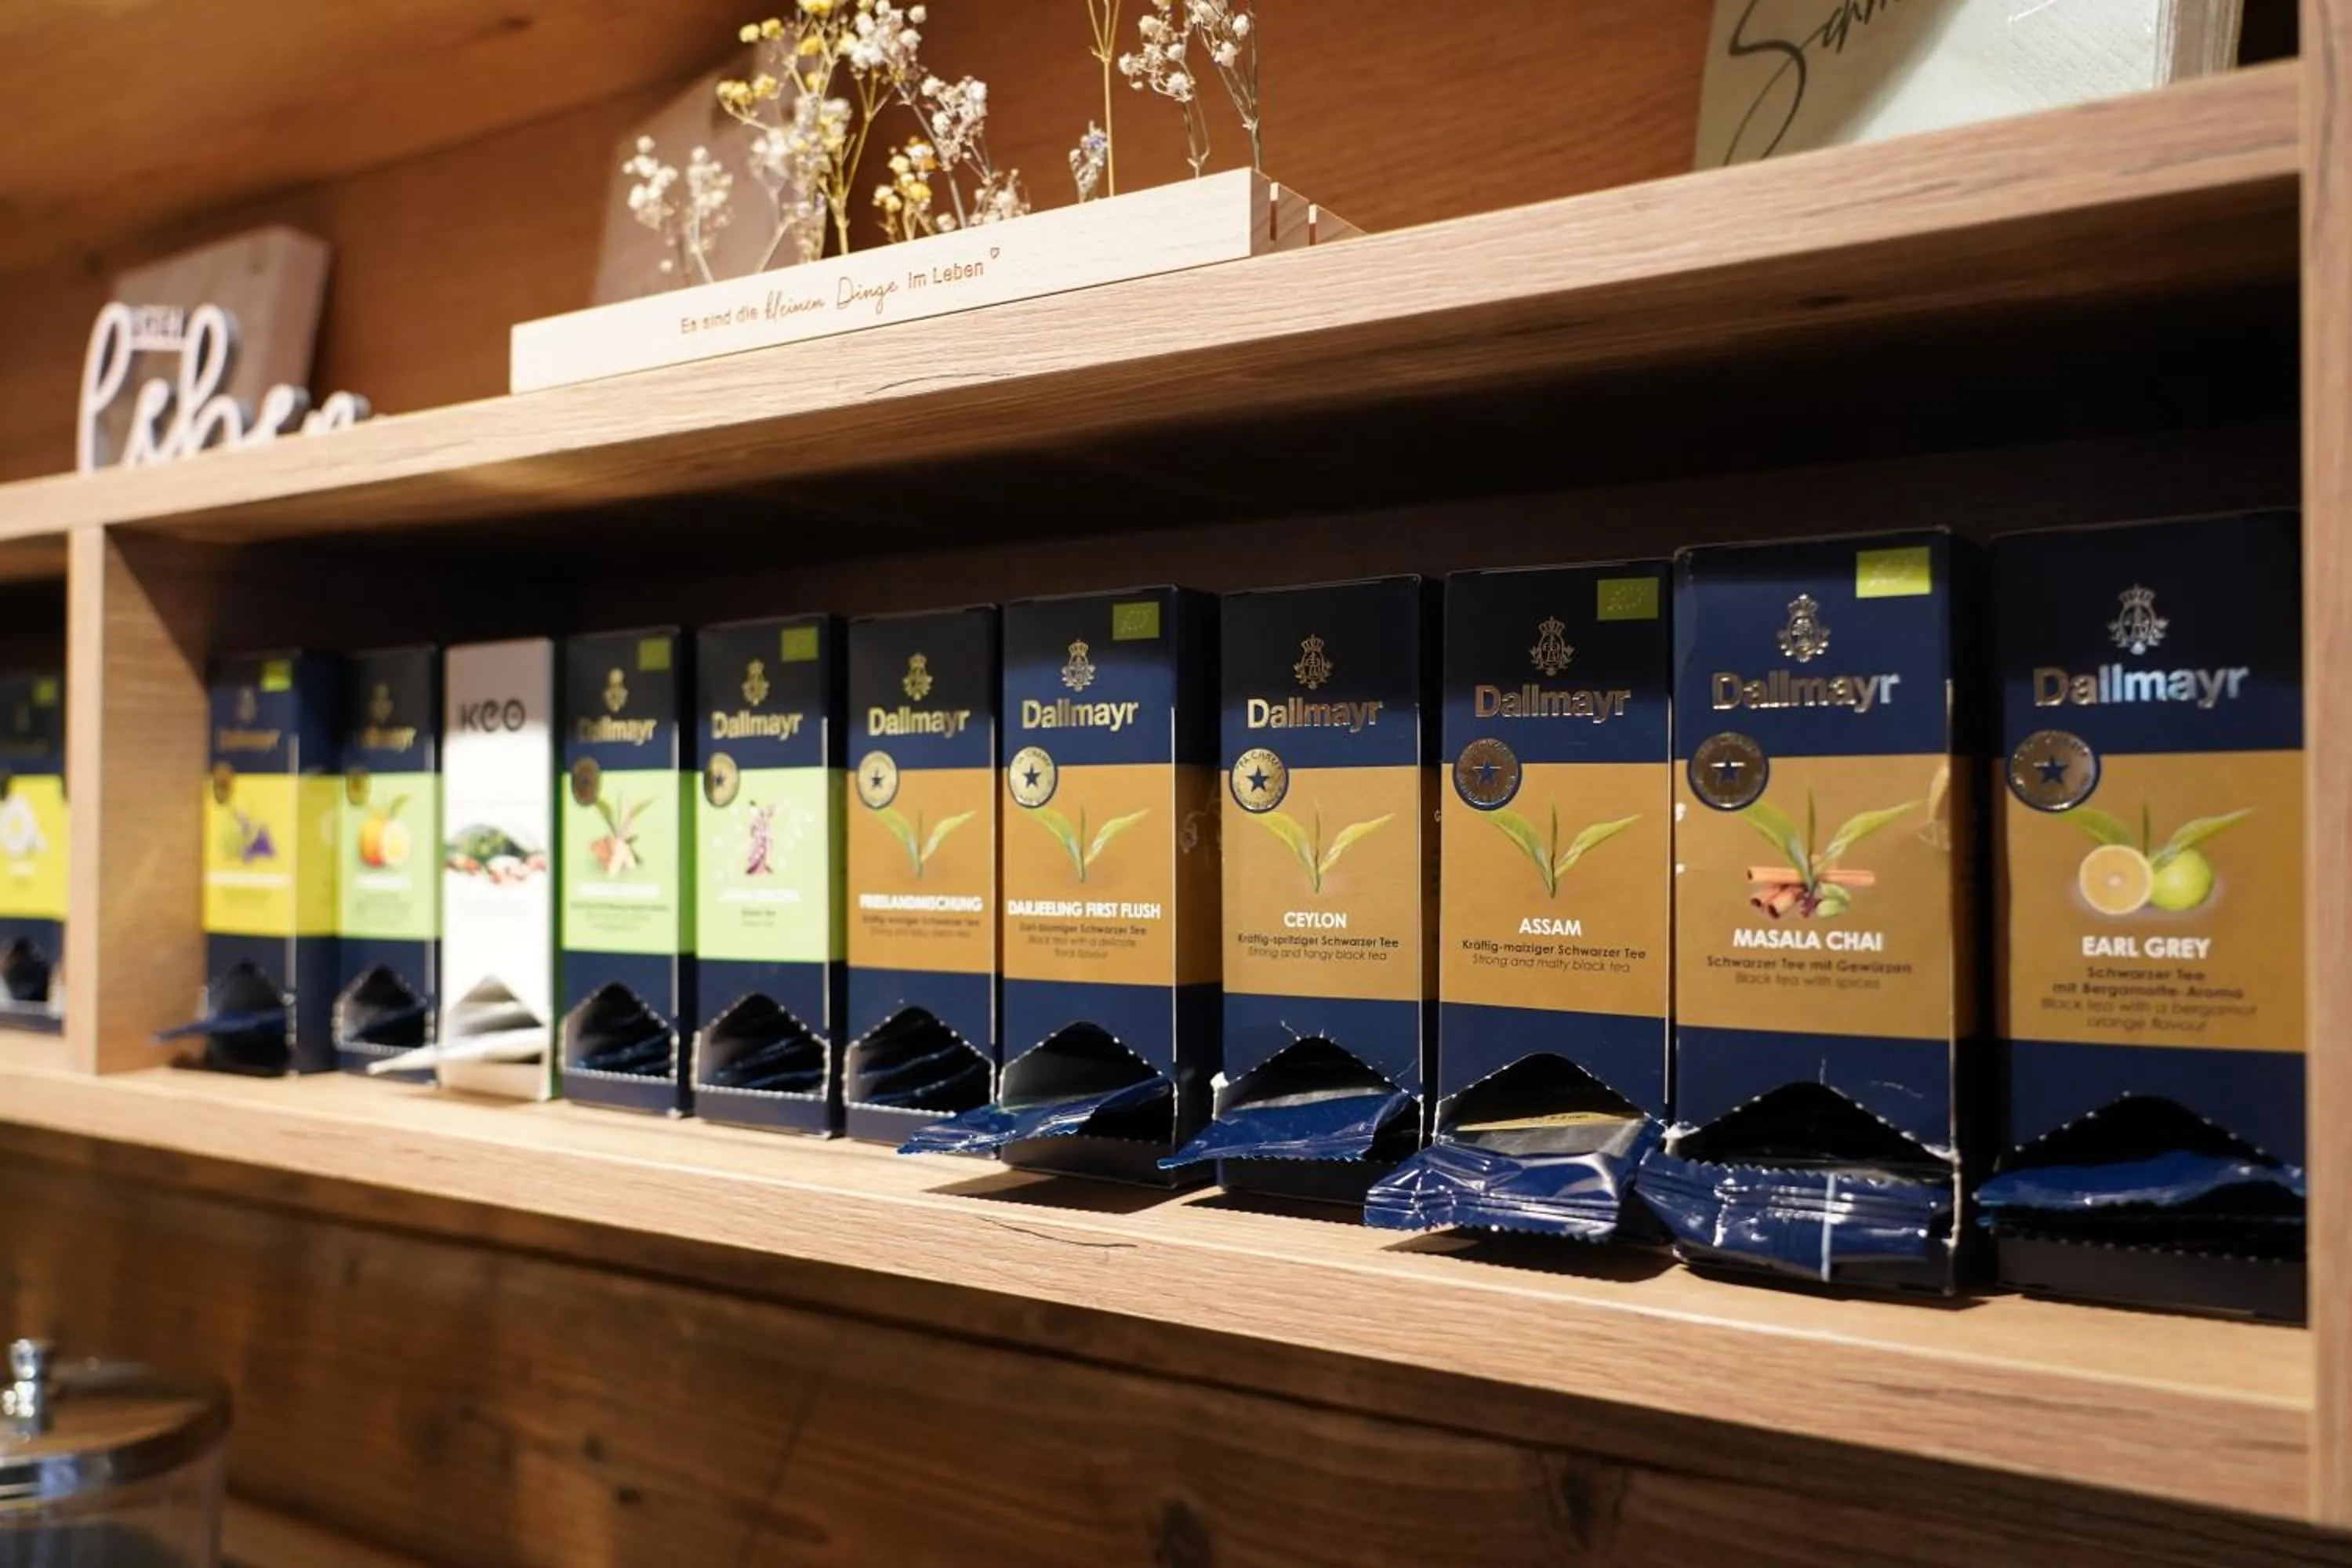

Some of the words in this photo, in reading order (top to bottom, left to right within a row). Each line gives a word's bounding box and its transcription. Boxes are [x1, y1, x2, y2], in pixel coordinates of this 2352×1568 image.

[681, 318, 698, 334] Es
[702, 310, 731, 329] sind
[736, 305, 759, 324] die
[836, 275, 899, 315] Dinge
[933, 261, 984, 285] Leben
[1711, 672, 1901, 713] Dallmayr
[2032, 664, 2249, 708] Dallmayr
[1021, 698, 1139, 731] Dallmayr
[1246, 697, 1384, 733] Dallmayr
[1475, 684, 1632, 724] Dallmayr
[711, 709, 804, 742] Dallmayr
[867, 706, 971, 739] Dallmayr
[1007, 899, 1083, 916] DARJEELING
[1085, 902, 1118, 919] FIRST
[1120, 902, 1162, 920] FLUSH
[1283, 911, 1348, 929] CEYLON
[1518, 917, 1582, 937] ASSAM
[1732, 927, 1821, 950] MASALA
[1825, 930, 1883, 952] CHAI
[1247, 946, 1279, 960] Strong
[1280, 948, 1301, 959] and
[1303, 948, 1334, 961] tangy
[1335, 948, 1366, 961] black
[1368, 949, 1388, 961] tea
[1321, 935, 1377, 948] Schwarzer
[1379, 937, 1400, 948] Tee
[1557, 944, 1621, 958] Schwarzer
[1623, 947, 1646, 960] Tee
[2081, 935, 2140, 958] EARL
[2143, 935, 2212, 960] GREY
[1472, 953, 1508, 969] Strong
[1510, 955, 1534, 968] and
[1571, 957, 1606, 972] black
[1609, 959, 1631, 973] tea
[1706, 954, 1777, 970] Schwarzer
[1781, 956, 1806, 971] Tee
[1809, 958, 1832, 971] mit
[2051, 982, 2078, 995] mit
